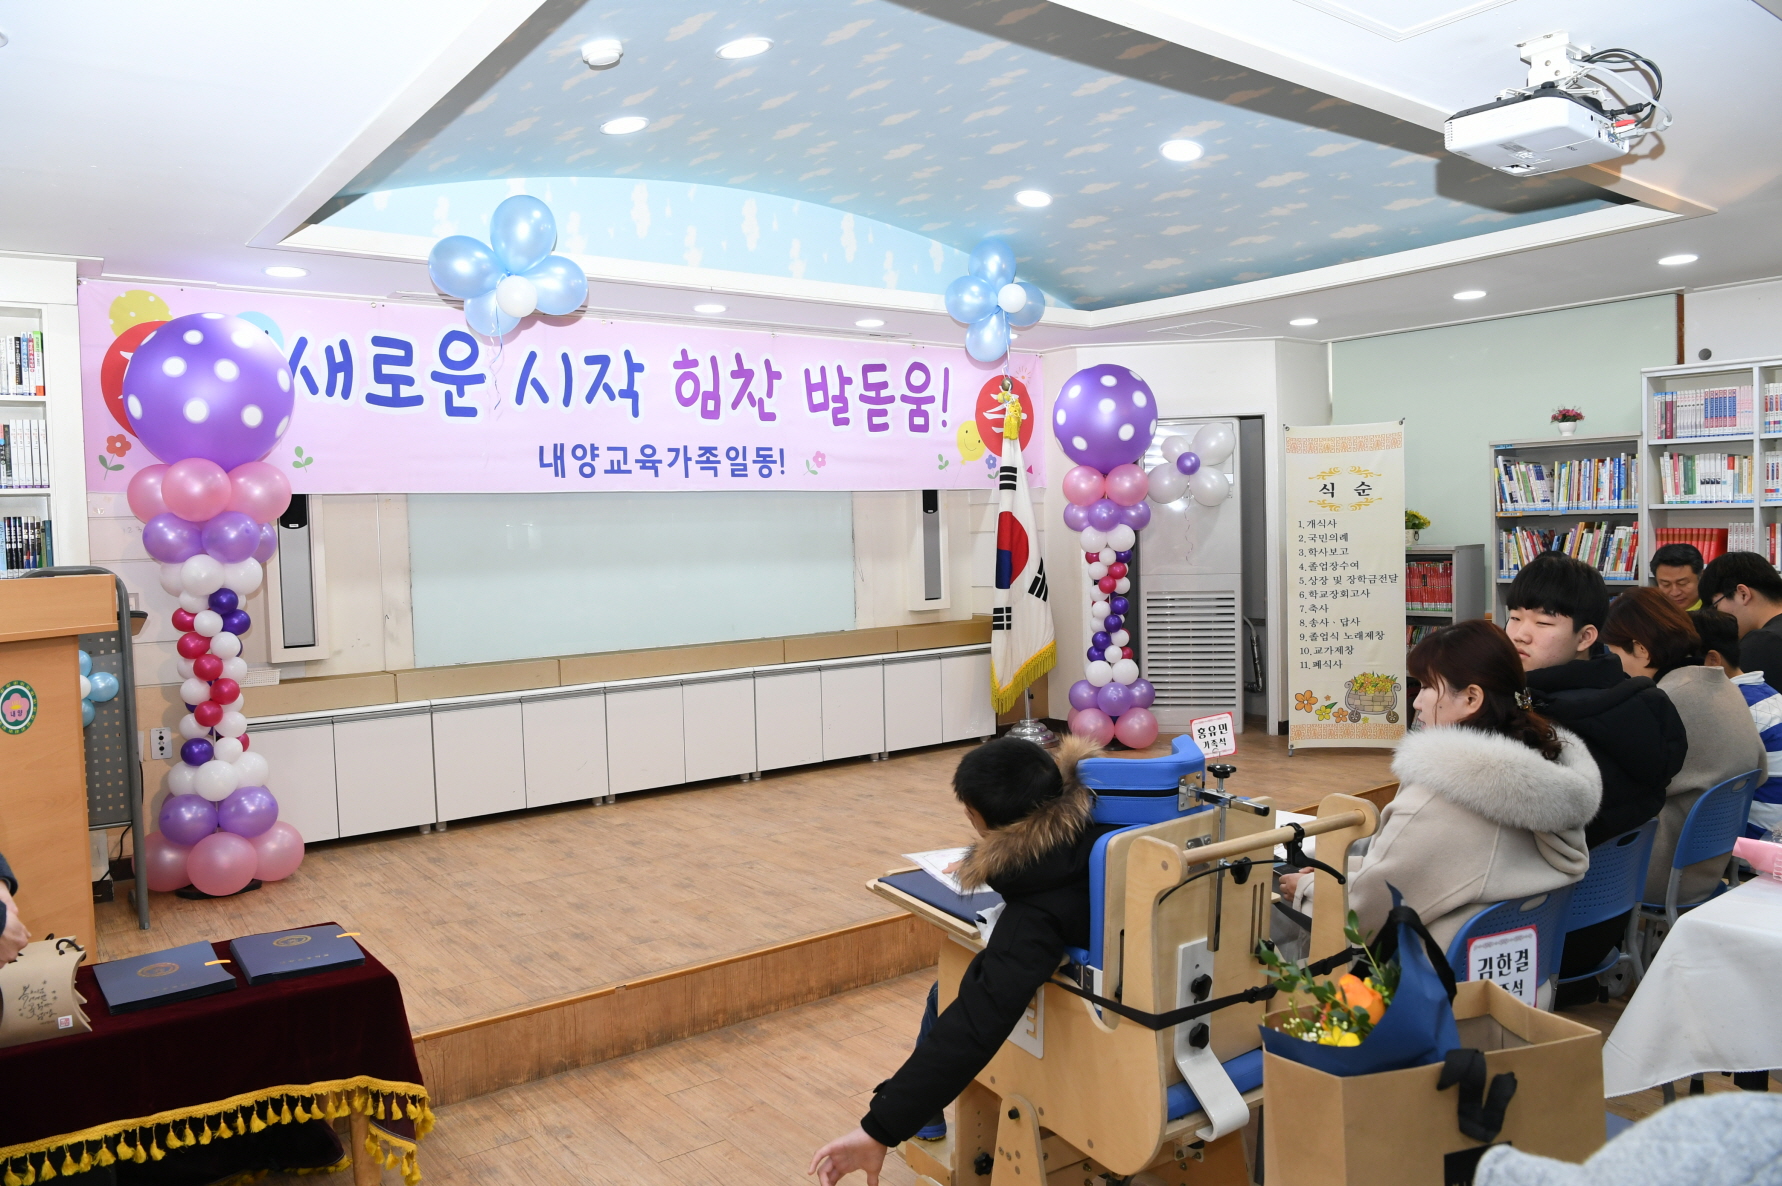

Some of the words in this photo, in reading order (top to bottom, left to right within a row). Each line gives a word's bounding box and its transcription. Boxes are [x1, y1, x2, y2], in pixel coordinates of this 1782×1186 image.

[288, 329, 487, 418] 새로운
[515, 349, 645, 419] 시작
[673, 348, 782, 420] 힘찬
[804, 361, 950, 433] 발돋움!
[538, 443, 786, 479] 내양교육가족일동!
[1333, 575, 1342, 585] 및
[1346, 573, 1399, 584] 장학금전달
[1343, 630, 1385, 641] 노래제창
[1197, 723, 1228, 739] 홍유민
[1477, 948, 1529, 980] 김한결
